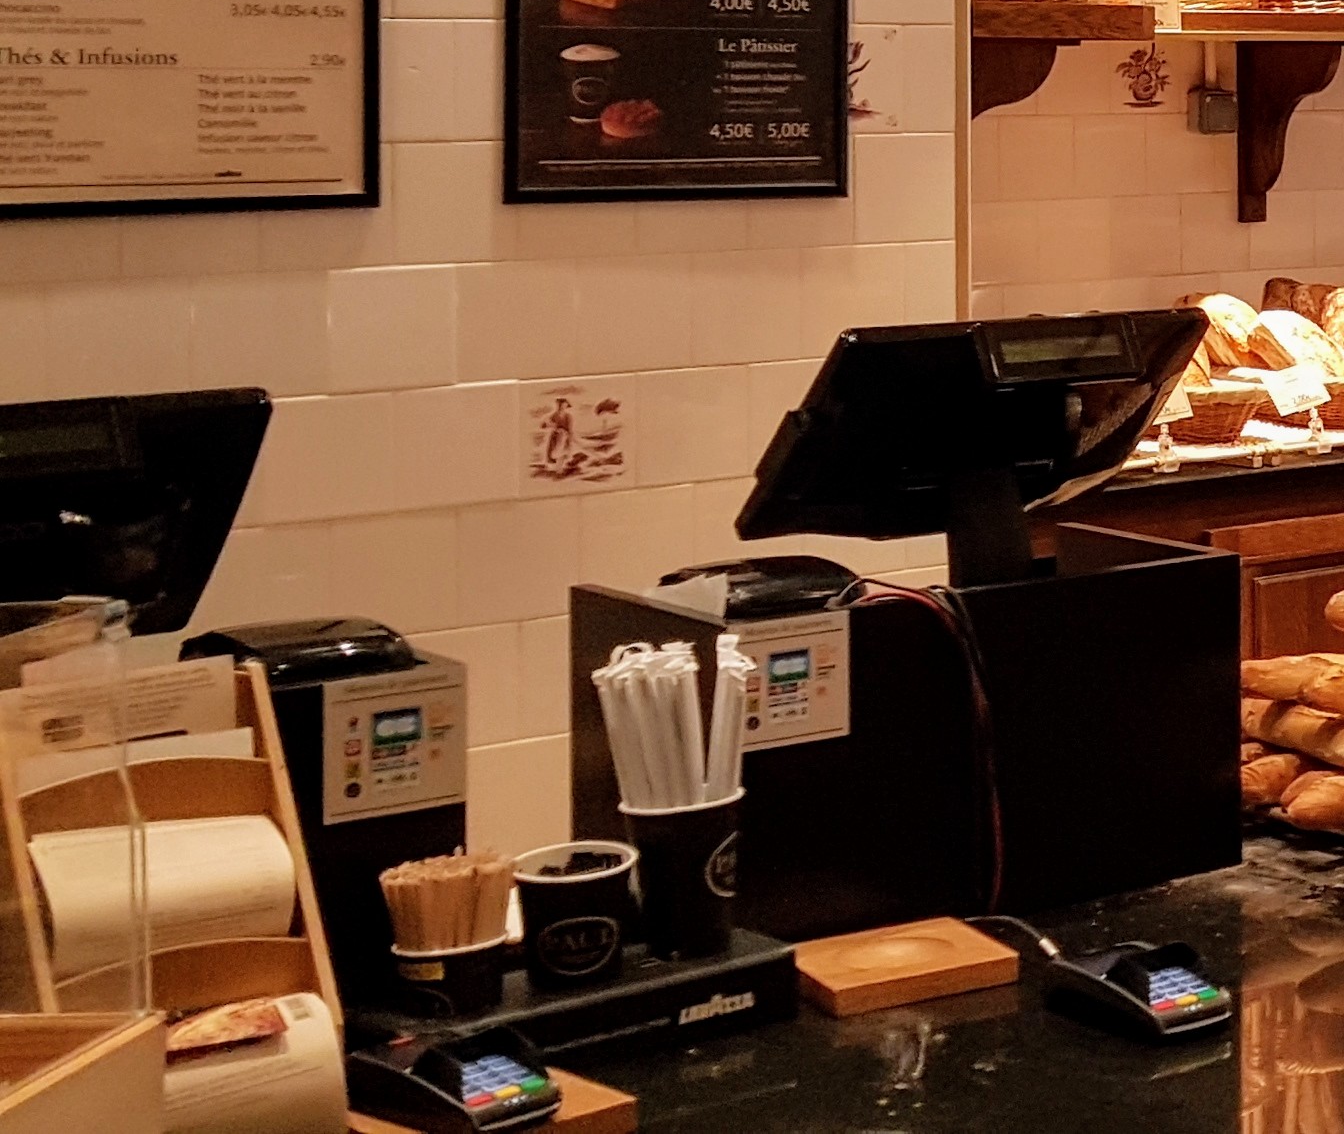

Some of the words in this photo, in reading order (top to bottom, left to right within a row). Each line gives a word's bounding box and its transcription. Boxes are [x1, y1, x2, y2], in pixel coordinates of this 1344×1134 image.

[718, 38, 736, 52] Le
[740, 38, 798, 53] Pâtissier
[50, 49, 69, 65] &
[78, 48, 178, 65] Infusions
[709, 123, 754, 140] 4,50€
[768, 123, 810, 139] 5,00€
